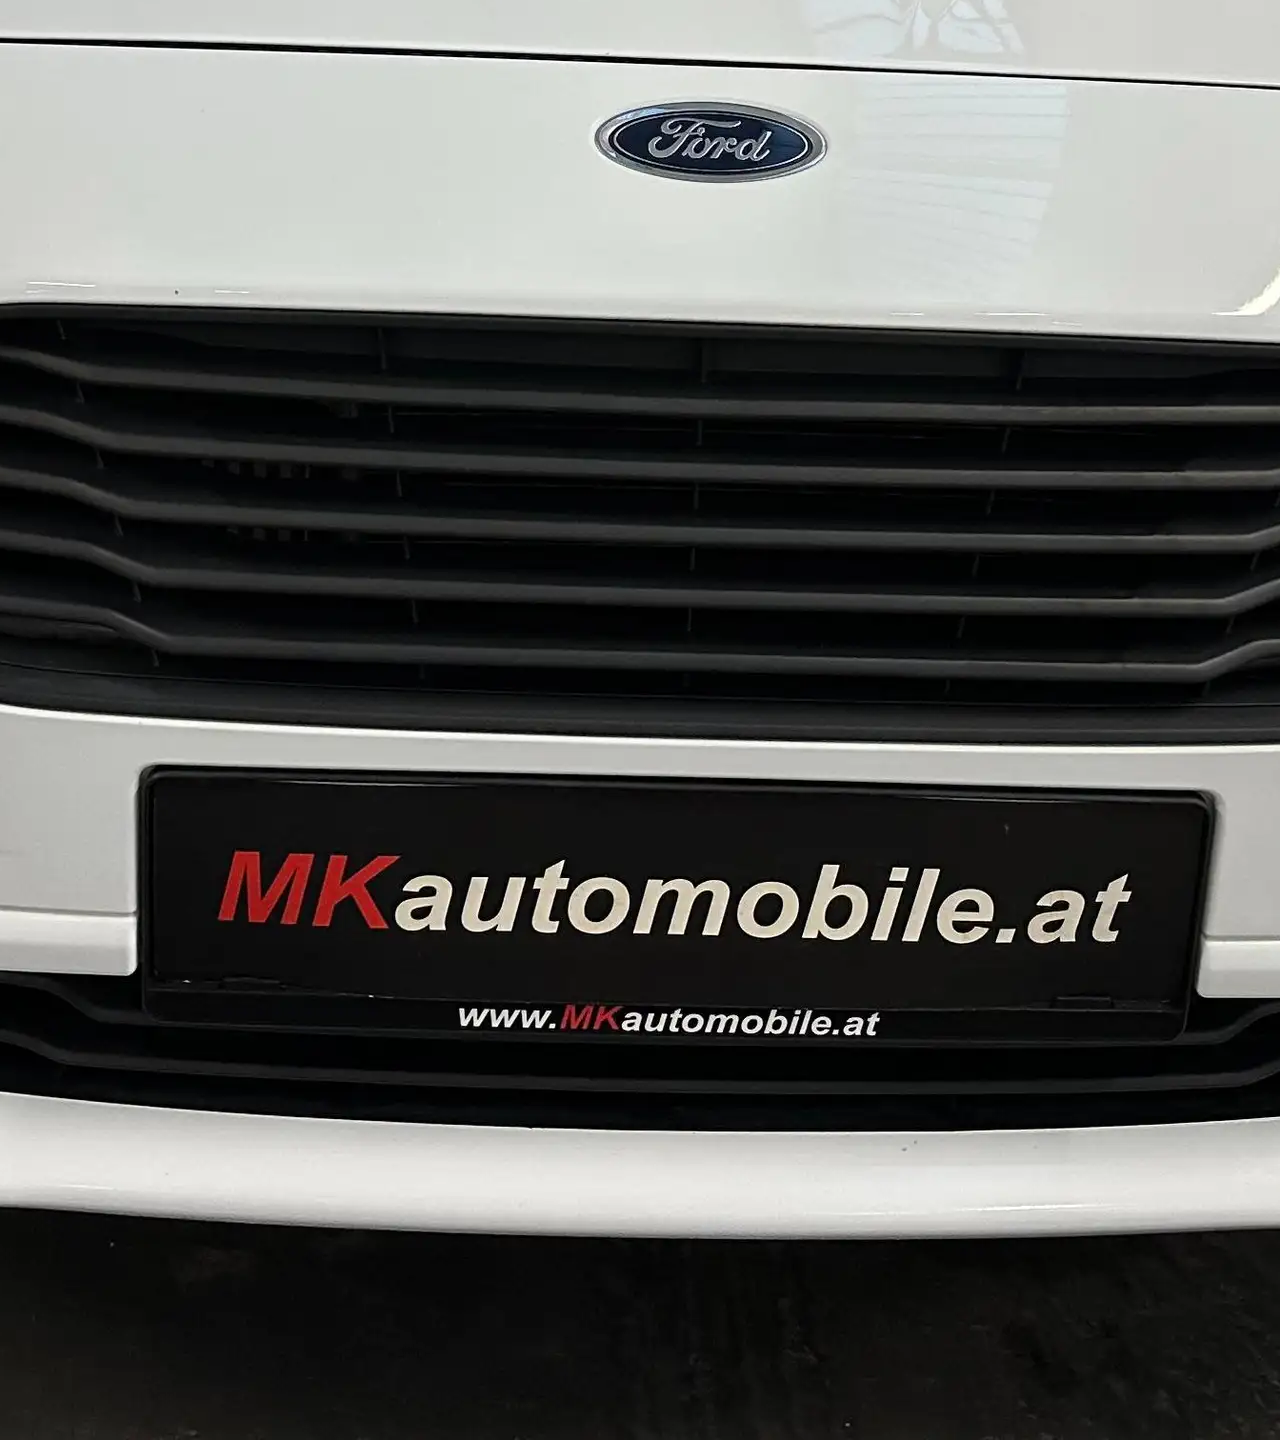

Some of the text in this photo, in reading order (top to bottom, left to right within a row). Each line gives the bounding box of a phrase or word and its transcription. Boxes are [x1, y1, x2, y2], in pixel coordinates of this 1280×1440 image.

[647, 117, 772, 162] Ford
[217, 850, 1133, 945] MKautomobile.at
[458, 1003, 881, 1037] www.MKautomobile.at
